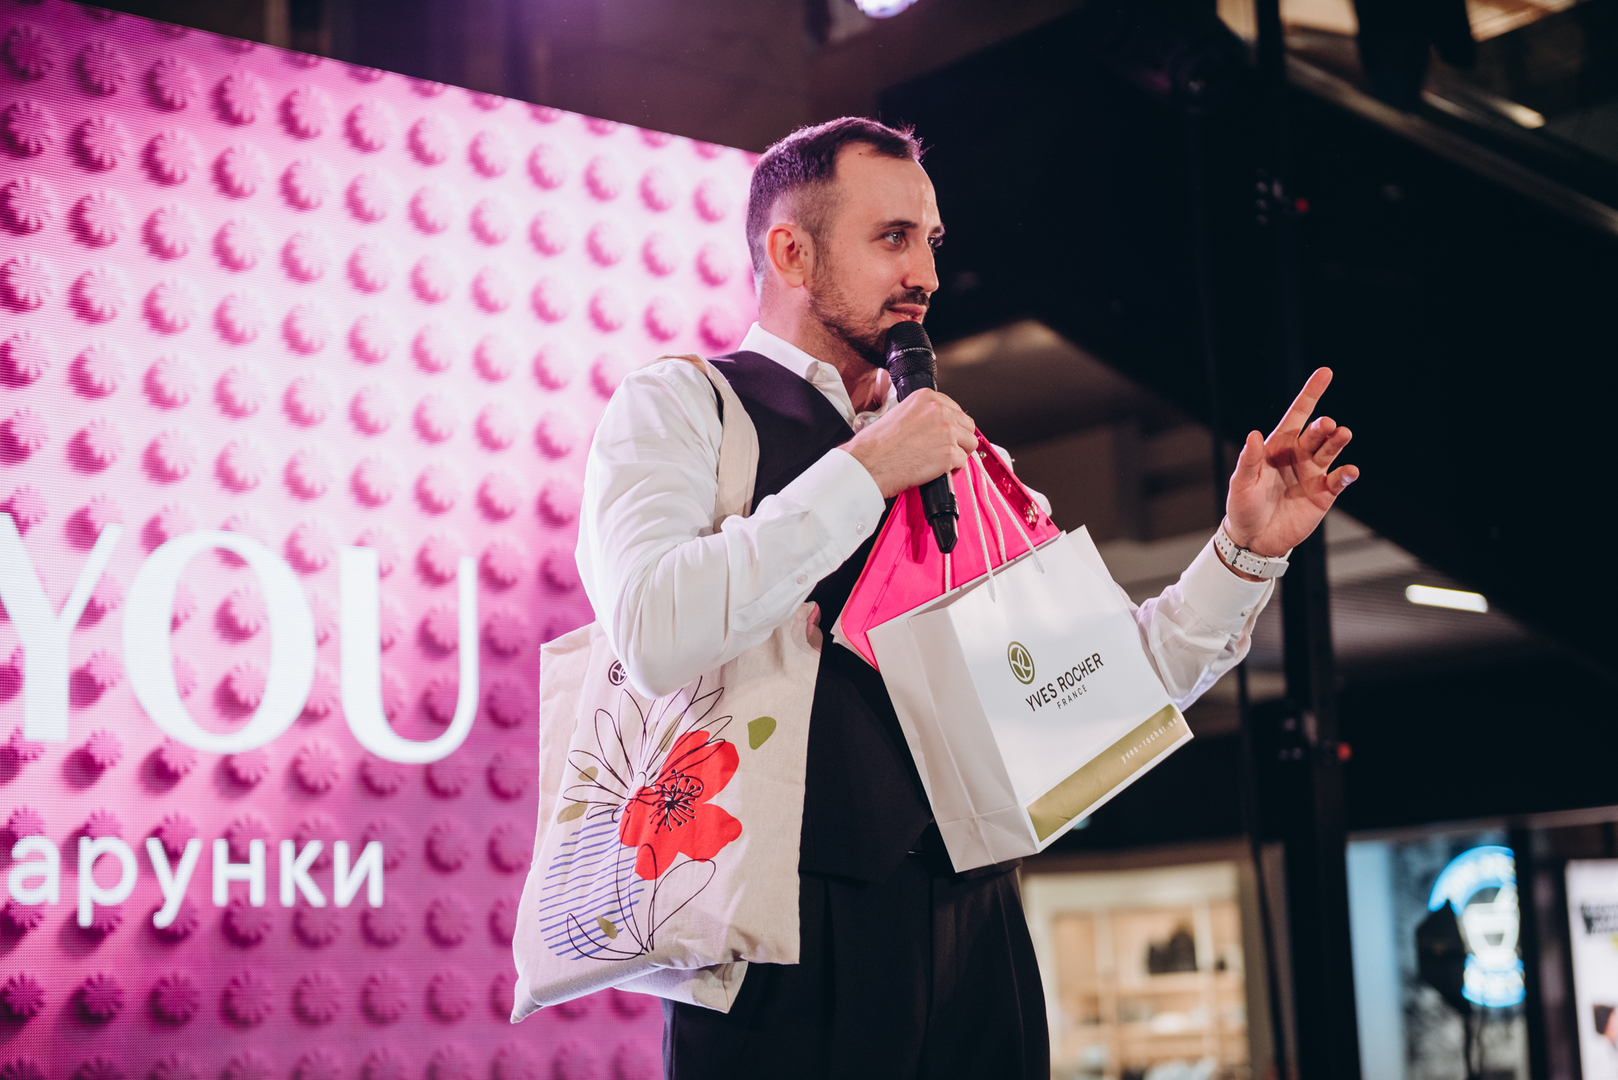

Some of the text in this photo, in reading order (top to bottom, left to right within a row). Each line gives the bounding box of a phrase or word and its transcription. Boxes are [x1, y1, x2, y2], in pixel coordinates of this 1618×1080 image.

[0, 512, 479, 764] YOU
[1025, 653, 1104, 712] YVES ROCHER
[1056, 684, 1087, 709] FRANCE
[8, 835, 384, 929] арунки
